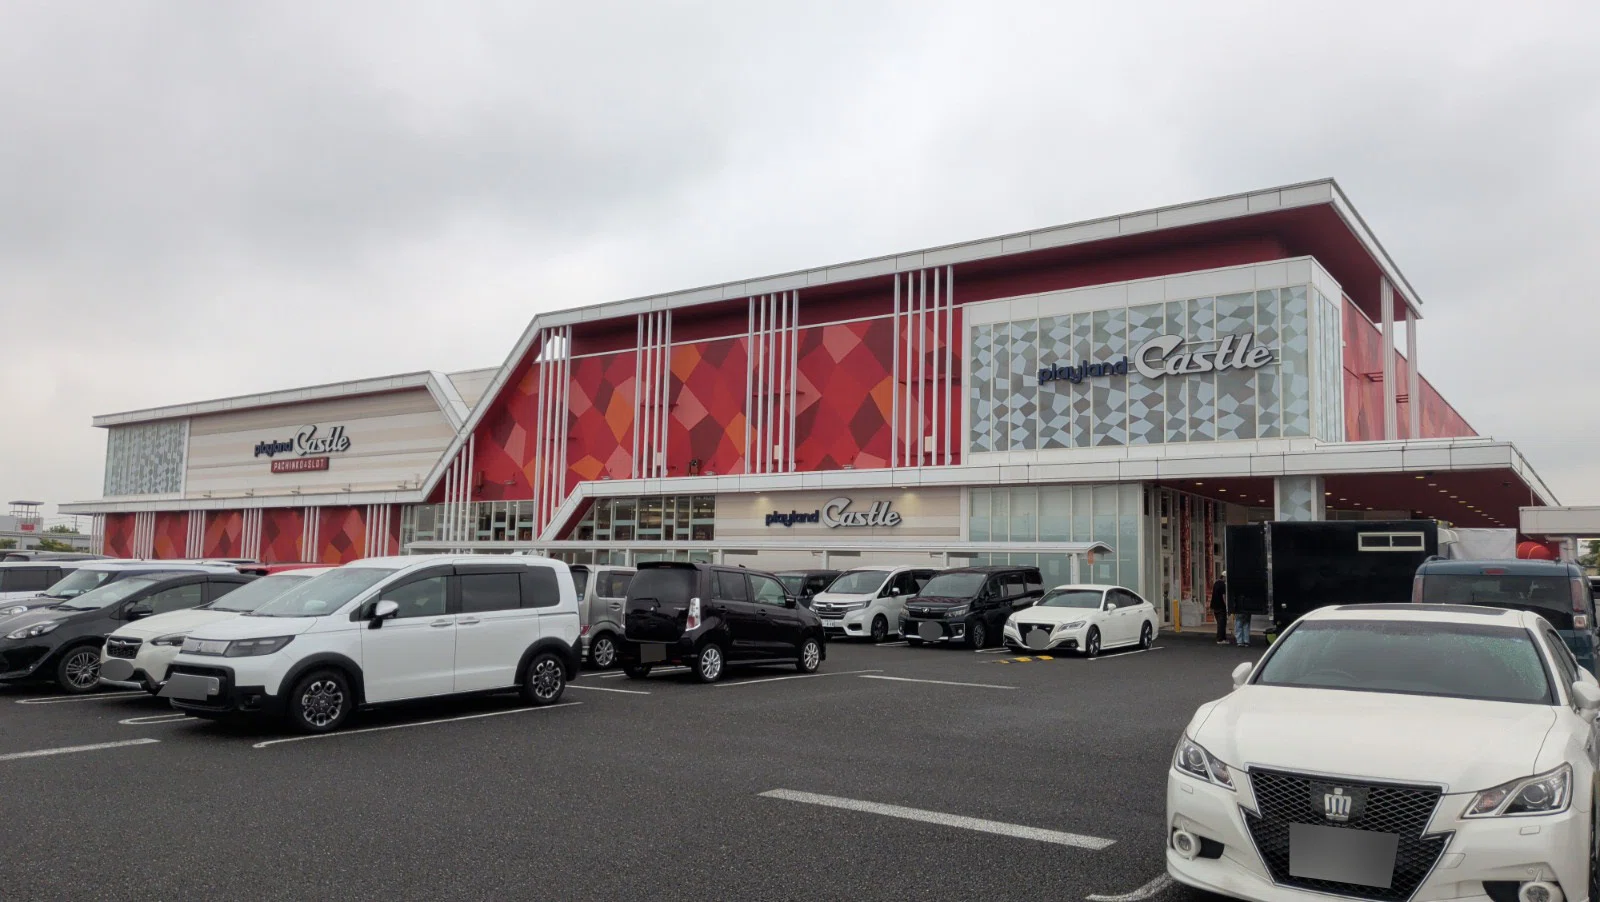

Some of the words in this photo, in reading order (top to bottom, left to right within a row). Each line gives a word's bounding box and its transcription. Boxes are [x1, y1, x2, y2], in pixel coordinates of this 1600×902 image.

[1038, 356, 1128, 385] playland
[1134, 332, 1274, 379] Castle
[254, 438, 293, 457] playland
[294, 424, 351, 456] Castle
[765, 509, 820, 527] playland
[822, 497, 902, 528] Castle
